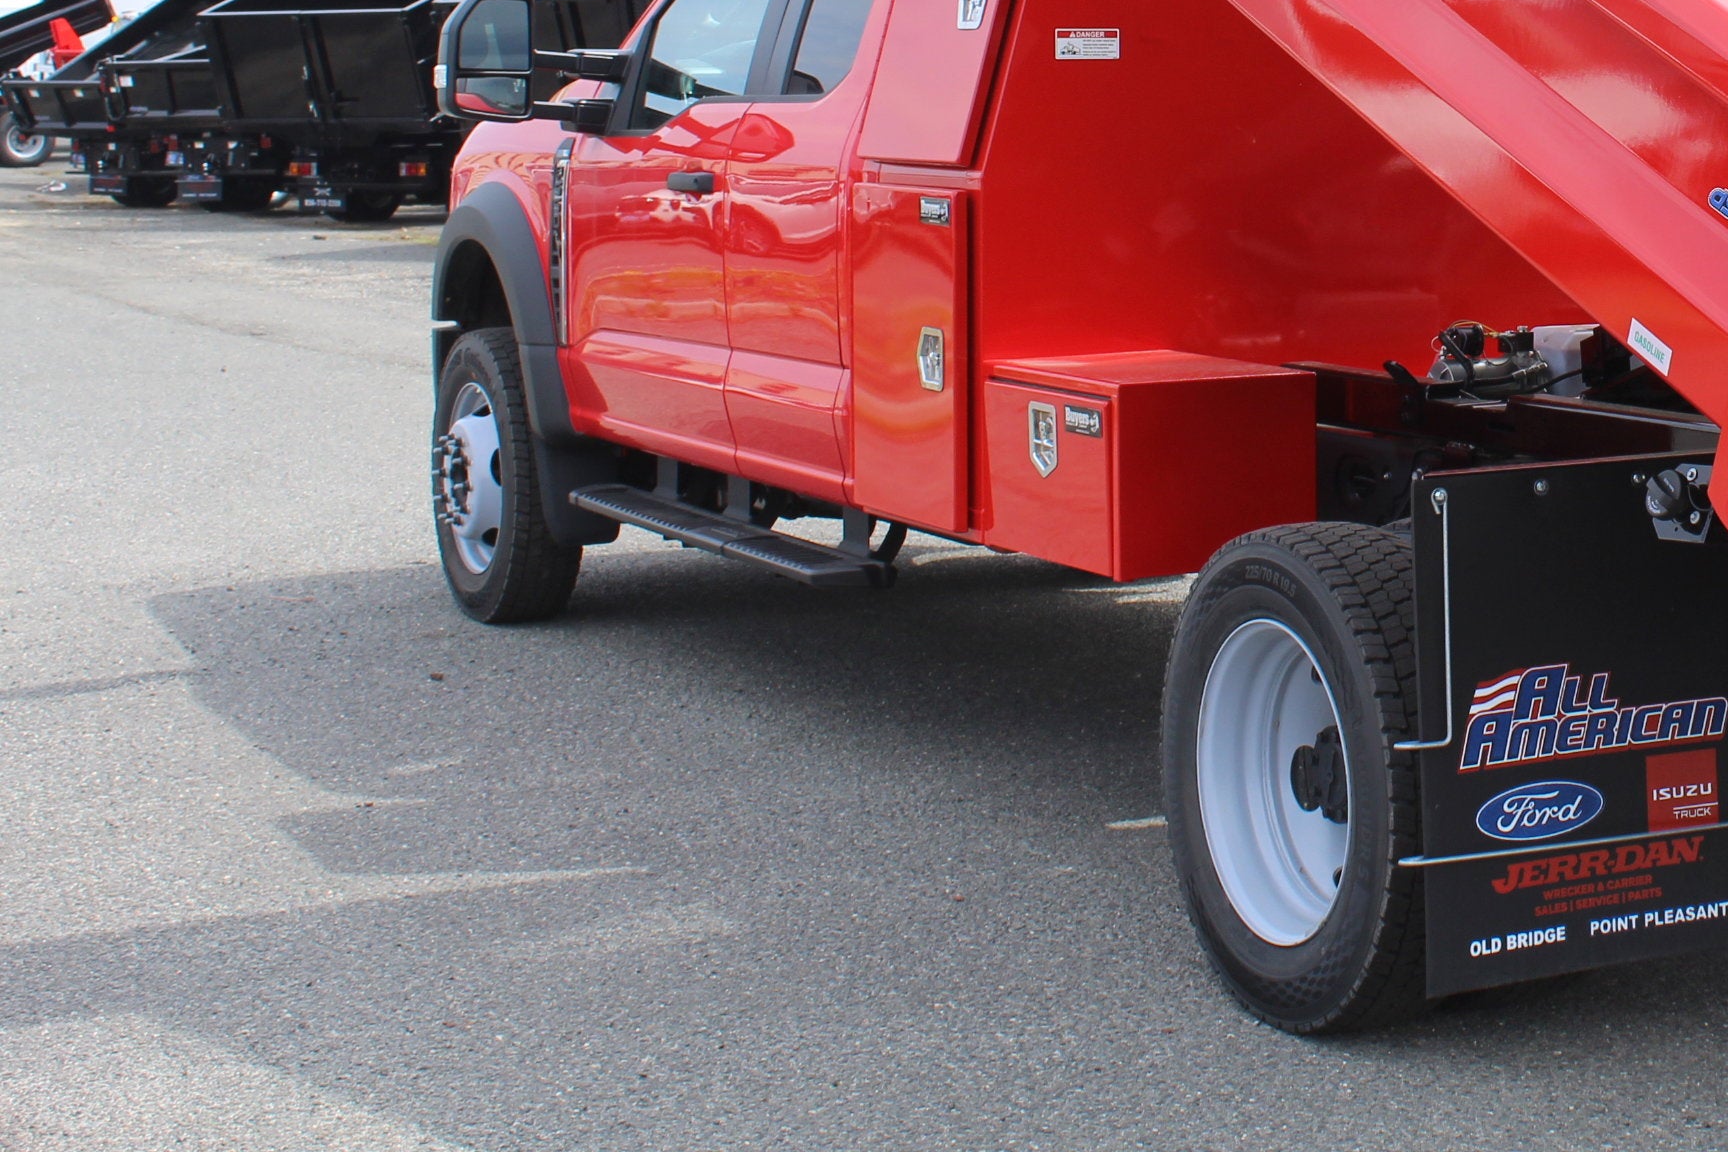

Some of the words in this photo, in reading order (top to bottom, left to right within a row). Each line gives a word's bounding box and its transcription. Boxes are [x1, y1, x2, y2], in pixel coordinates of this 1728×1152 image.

[1634, 330, 1666, 365] GASOLINE
[1512, 663, 1618, 723] ALL
[1652, 782, 1713, 801] ISUZU
[1497, 790, 1583, 833] Ford
[1673, 807, 1712, 820] TRUCK
[1491, 835, 1705, 895] JERR-DAN
[1533, 901, 1568, 917] SALES
[1575, 894, 1621, 913] SERVICE
[1627, 887, 1663, 902] PARTS
[1542, 880, 1595, 901] WRECKER
[1606, 874, 1654, 891] CARRIER
[1470, 938, 1502, 958] OLD
[1506, 925, 1567, 952] BRIDGE
[1590, 914, 1640, 937] POINT
